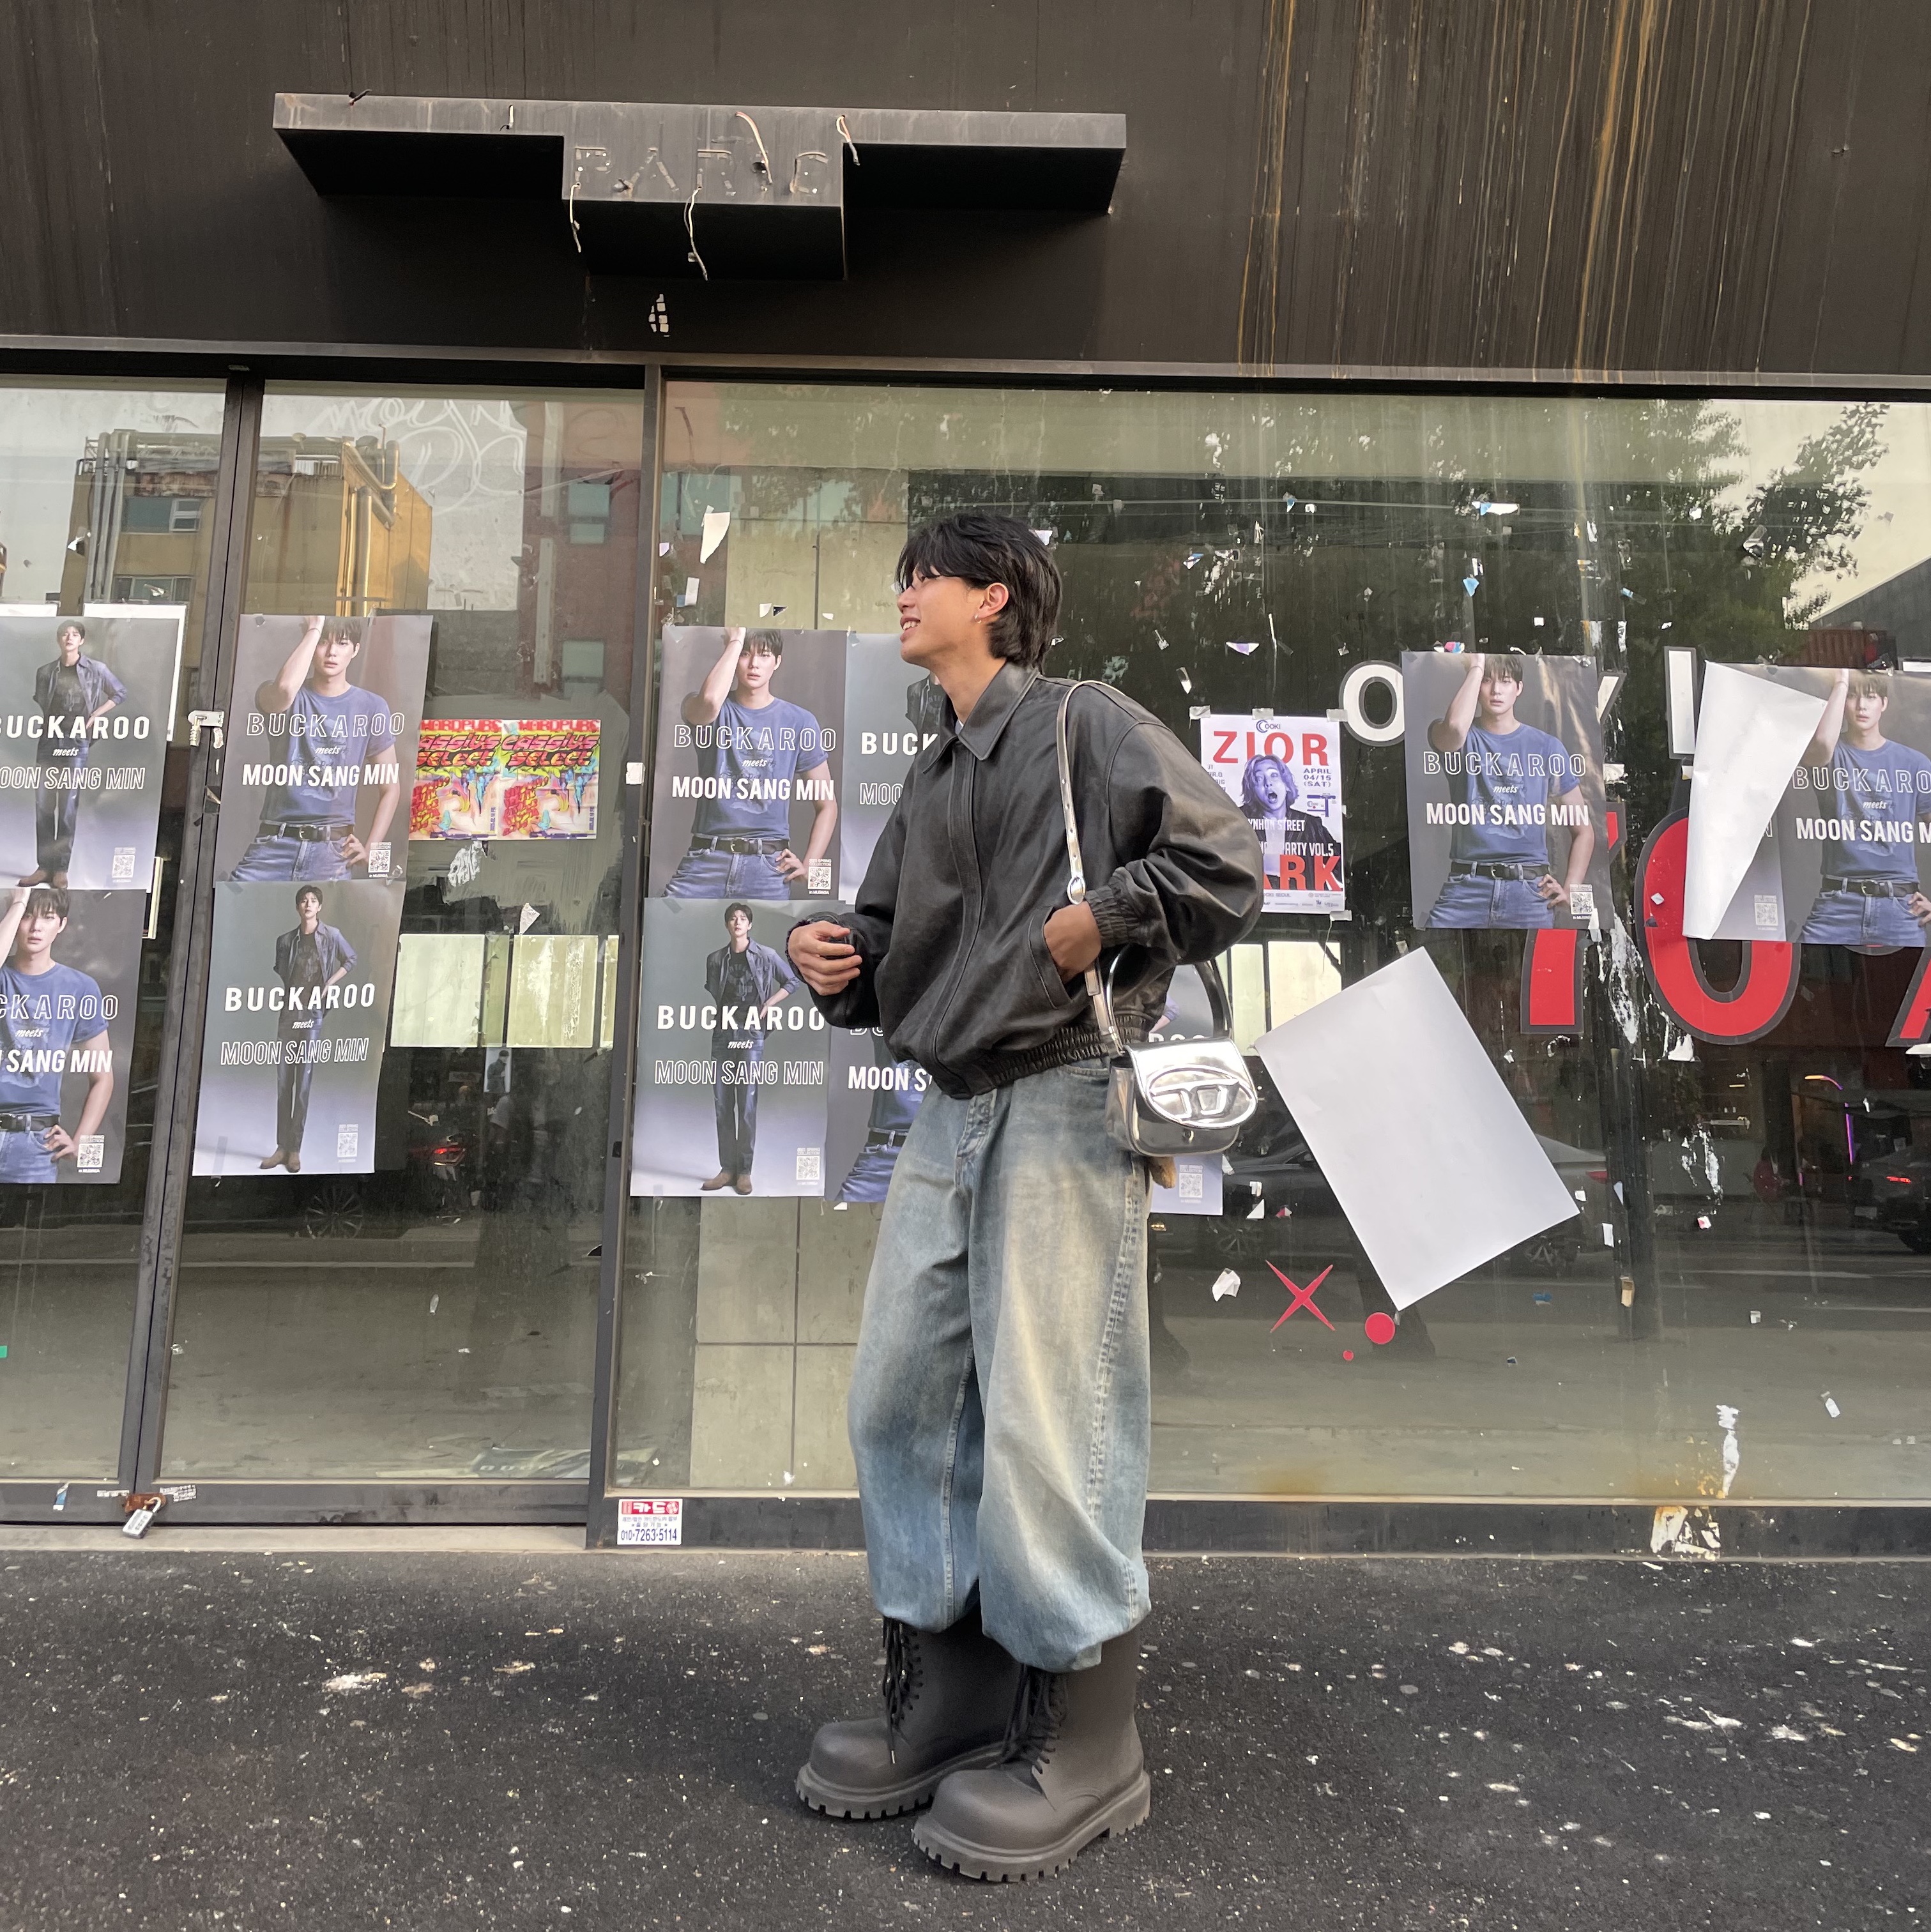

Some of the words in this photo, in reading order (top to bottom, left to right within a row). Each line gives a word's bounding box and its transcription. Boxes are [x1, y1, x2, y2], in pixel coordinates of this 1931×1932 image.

[0, 715, 150, 740] UCKAROO
[247, 712, 405, 738] BUCKAROO
[674, 724, 836, 751] BUCKAROO
[1213, 731, 1329, 766] ZIOR
[52, 747, 79, 756] meets
[315, 745, 341, 755] meets
[742, 757, 767, 768] meets
[1423, 751, 1586, 777] BUCKAROO
[44, 767, 102, 790] SANG
[105, 767, 146, 790] MIN
[242, 764, 303, 786] MOON
[308, 765, 360, 787] SANG
[363, 763, 400, 786] MIN
[672, 776, 731, 799] MOON
[736, 779, 791, 800] SANG
[796, 779, 834, 801] MIN
[1493, 784, 1518, 794] meets
[1426, 802, 1485, 825] MOON
[1490, 803, 1546, 826] SANG
[1551, 805, 1589, 826] MIN
[1863, 800, 1887, 809] meets
[1278, 819, 1305, 831] STREET
[1796, 818, 1856, 841] MOON
[1859, 819, 1913, 843] SANG
[1309, 842, 1334, 856] VOL.5
[224, 983, 376, 1012] BUCKAROO
[292, 1019, 314, 1029] meets
[657, 1005, 825, 1031] BUCKAROO
[15, 1028, 43, 1037] meets
[728, 1038, 754, 1049] meets
[6, 1049, 66, 1073] SANG
[70, 1049, 113, 1073] MIN
[220, 1041, 282, 1065] MOON
[285, 1038, 332, 1064] SANG
[334, 1037, 369, 1063] MIN
[654, 1060, 717, 1085] MOON
[721, 1060, 778, 1085] SANG
[783, 1061, 824, 1086] MIN
[848, 1065, 909, 1091] MOON
[913, 1068, 933, 1092] S
[633, 1502, 666, 1514] 카드
